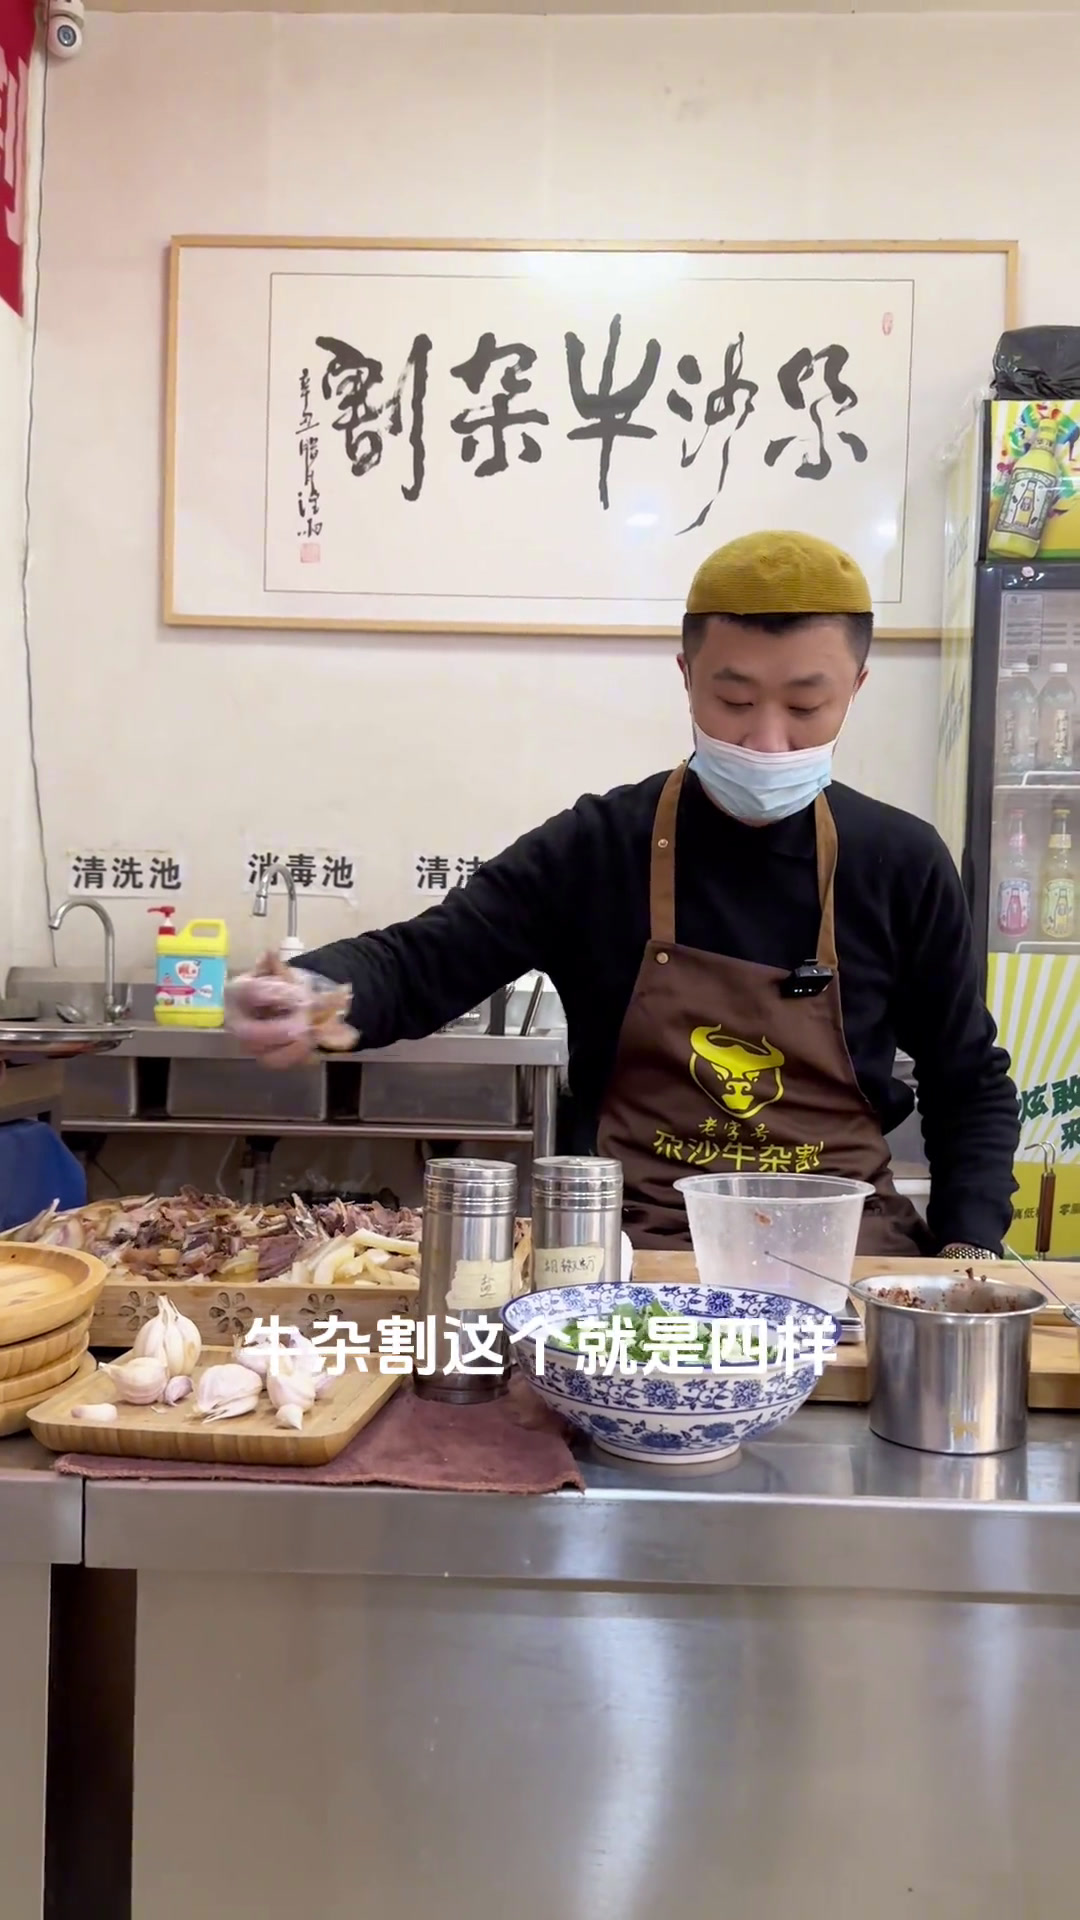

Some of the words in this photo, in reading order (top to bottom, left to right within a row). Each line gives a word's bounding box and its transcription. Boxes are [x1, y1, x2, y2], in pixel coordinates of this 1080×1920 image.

[72, 855, 182, 890] 清洗池
[248, 852, 354, 889] 消毒池
[698, 1116, 770, 1142] 老字号
